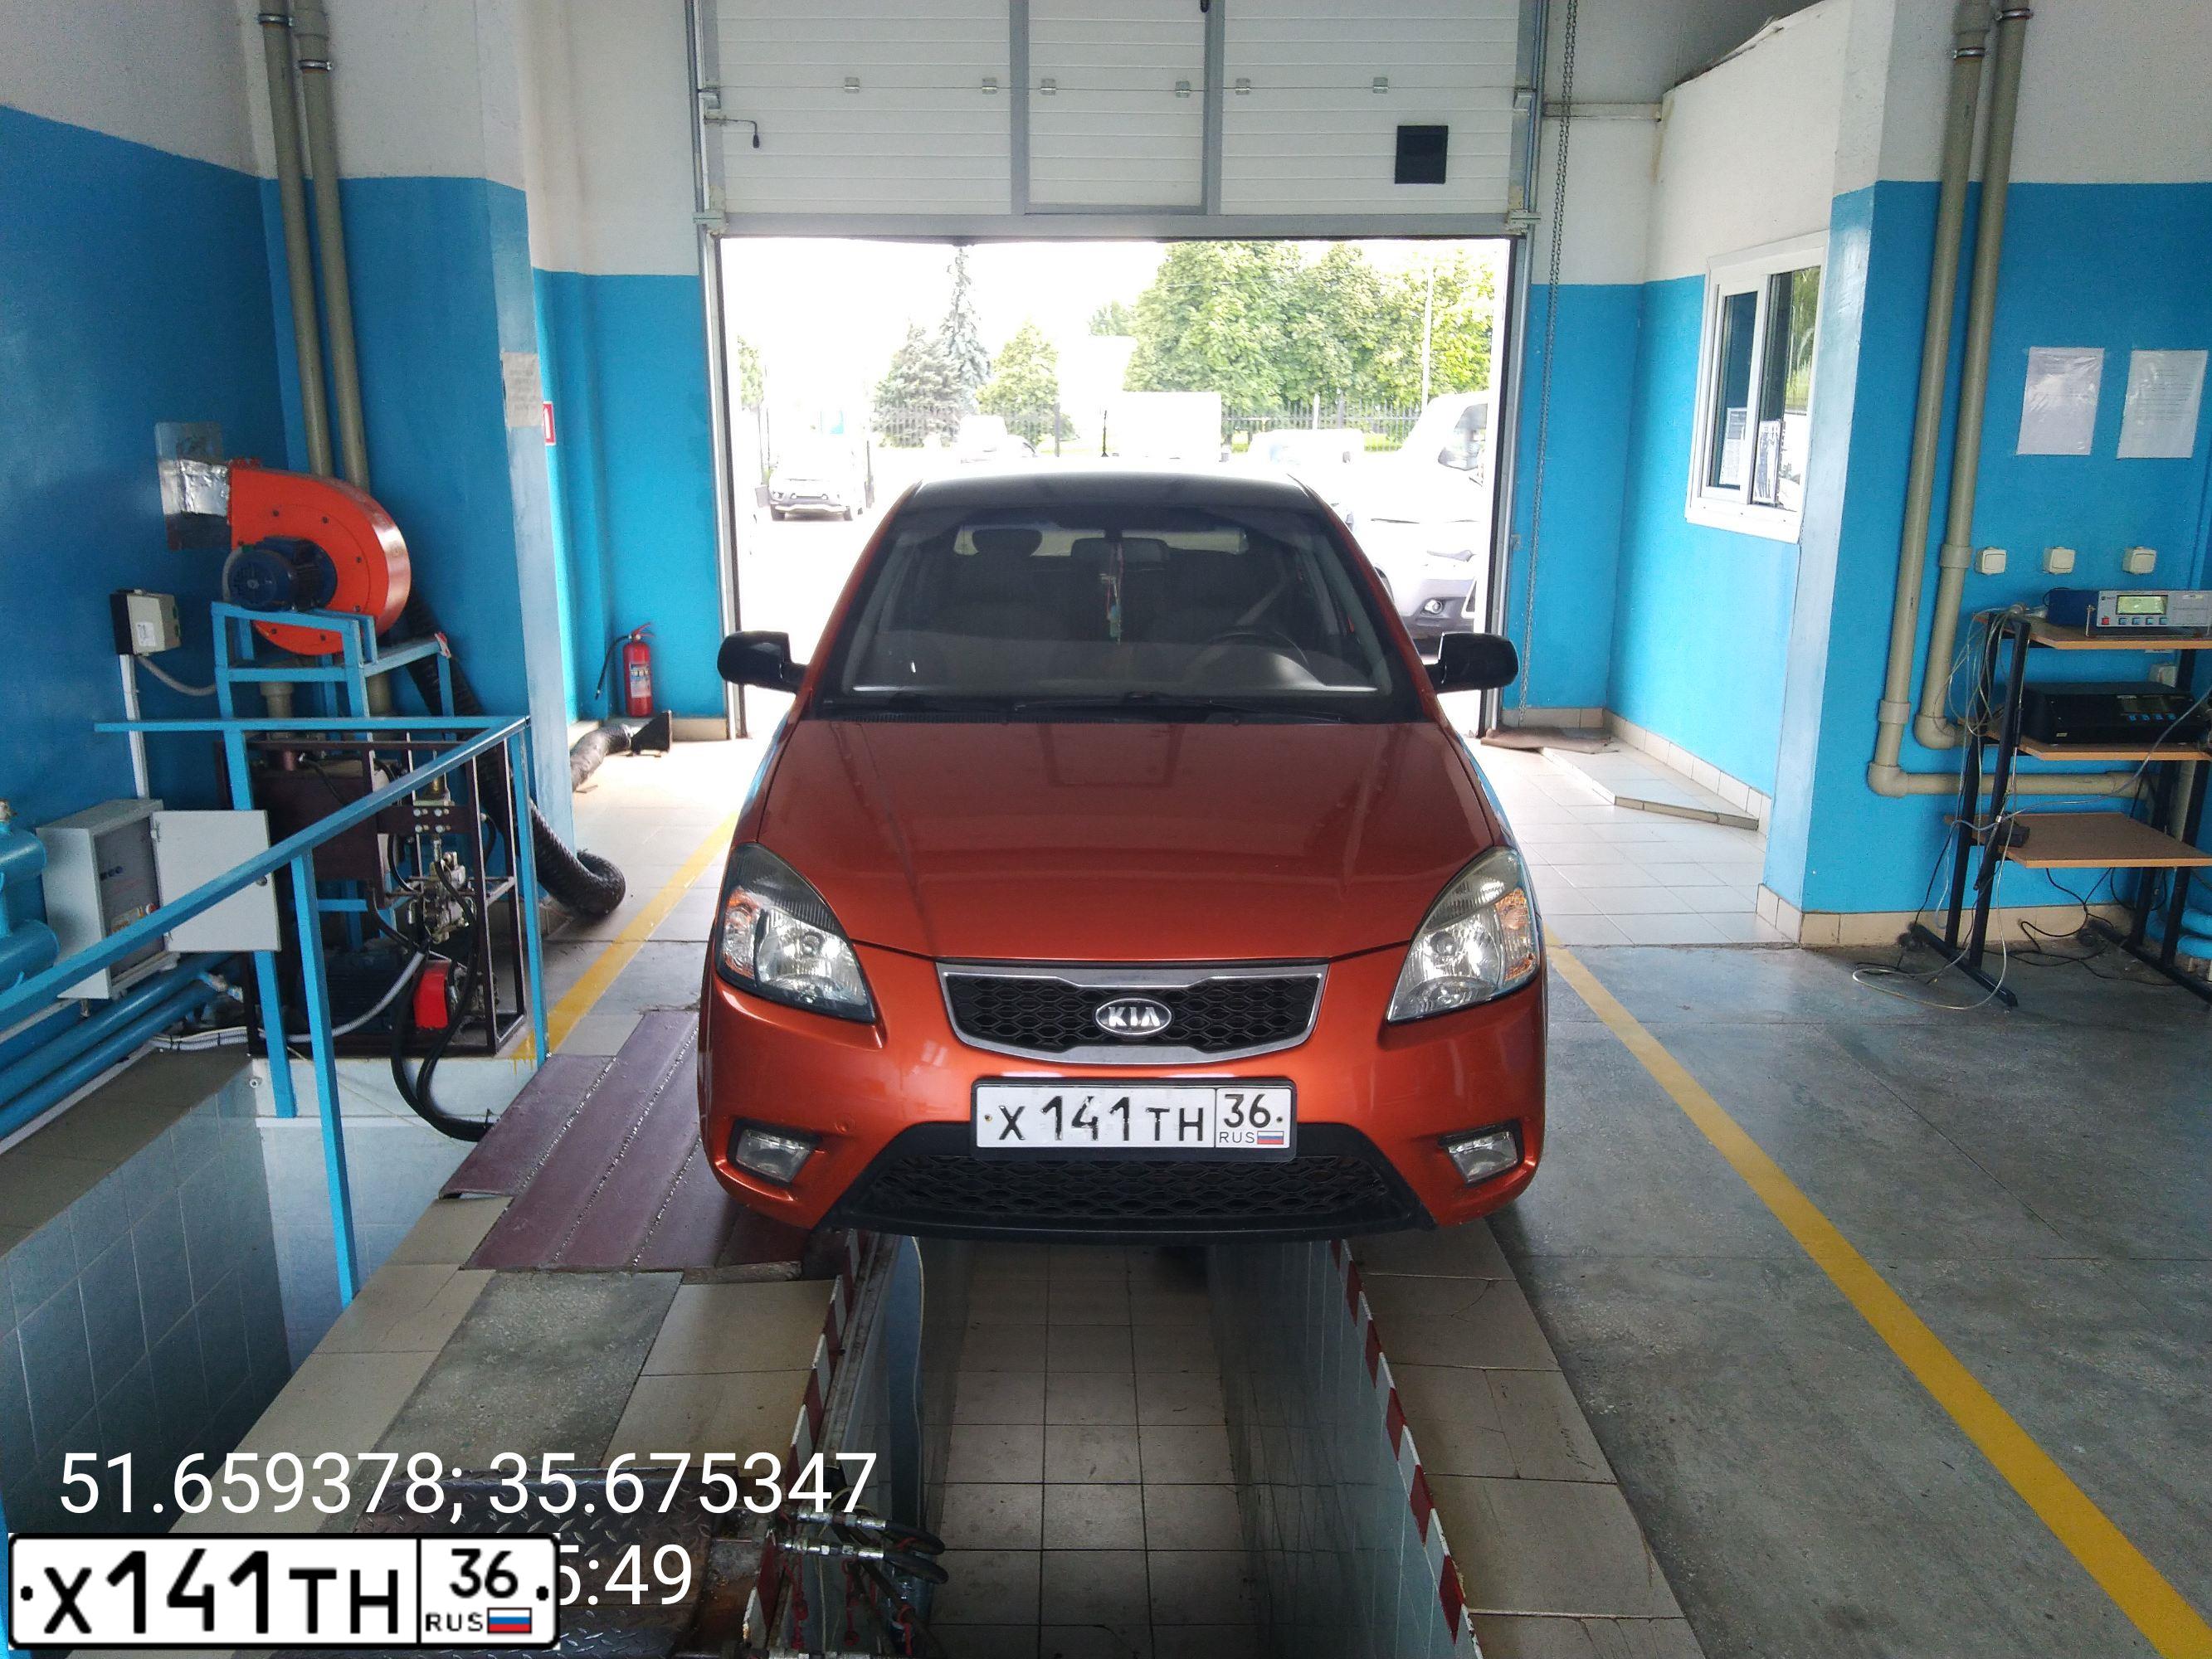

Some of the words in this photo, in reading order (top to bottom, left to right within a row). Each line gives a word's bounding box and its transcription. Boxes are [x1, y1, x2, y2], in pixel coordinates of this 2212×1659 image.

[1107, 1006, 1161, 1028] KIA
[1224, 1093, 1271, 1128] 36
[1219, 1131, 1255, 1144] RUS
